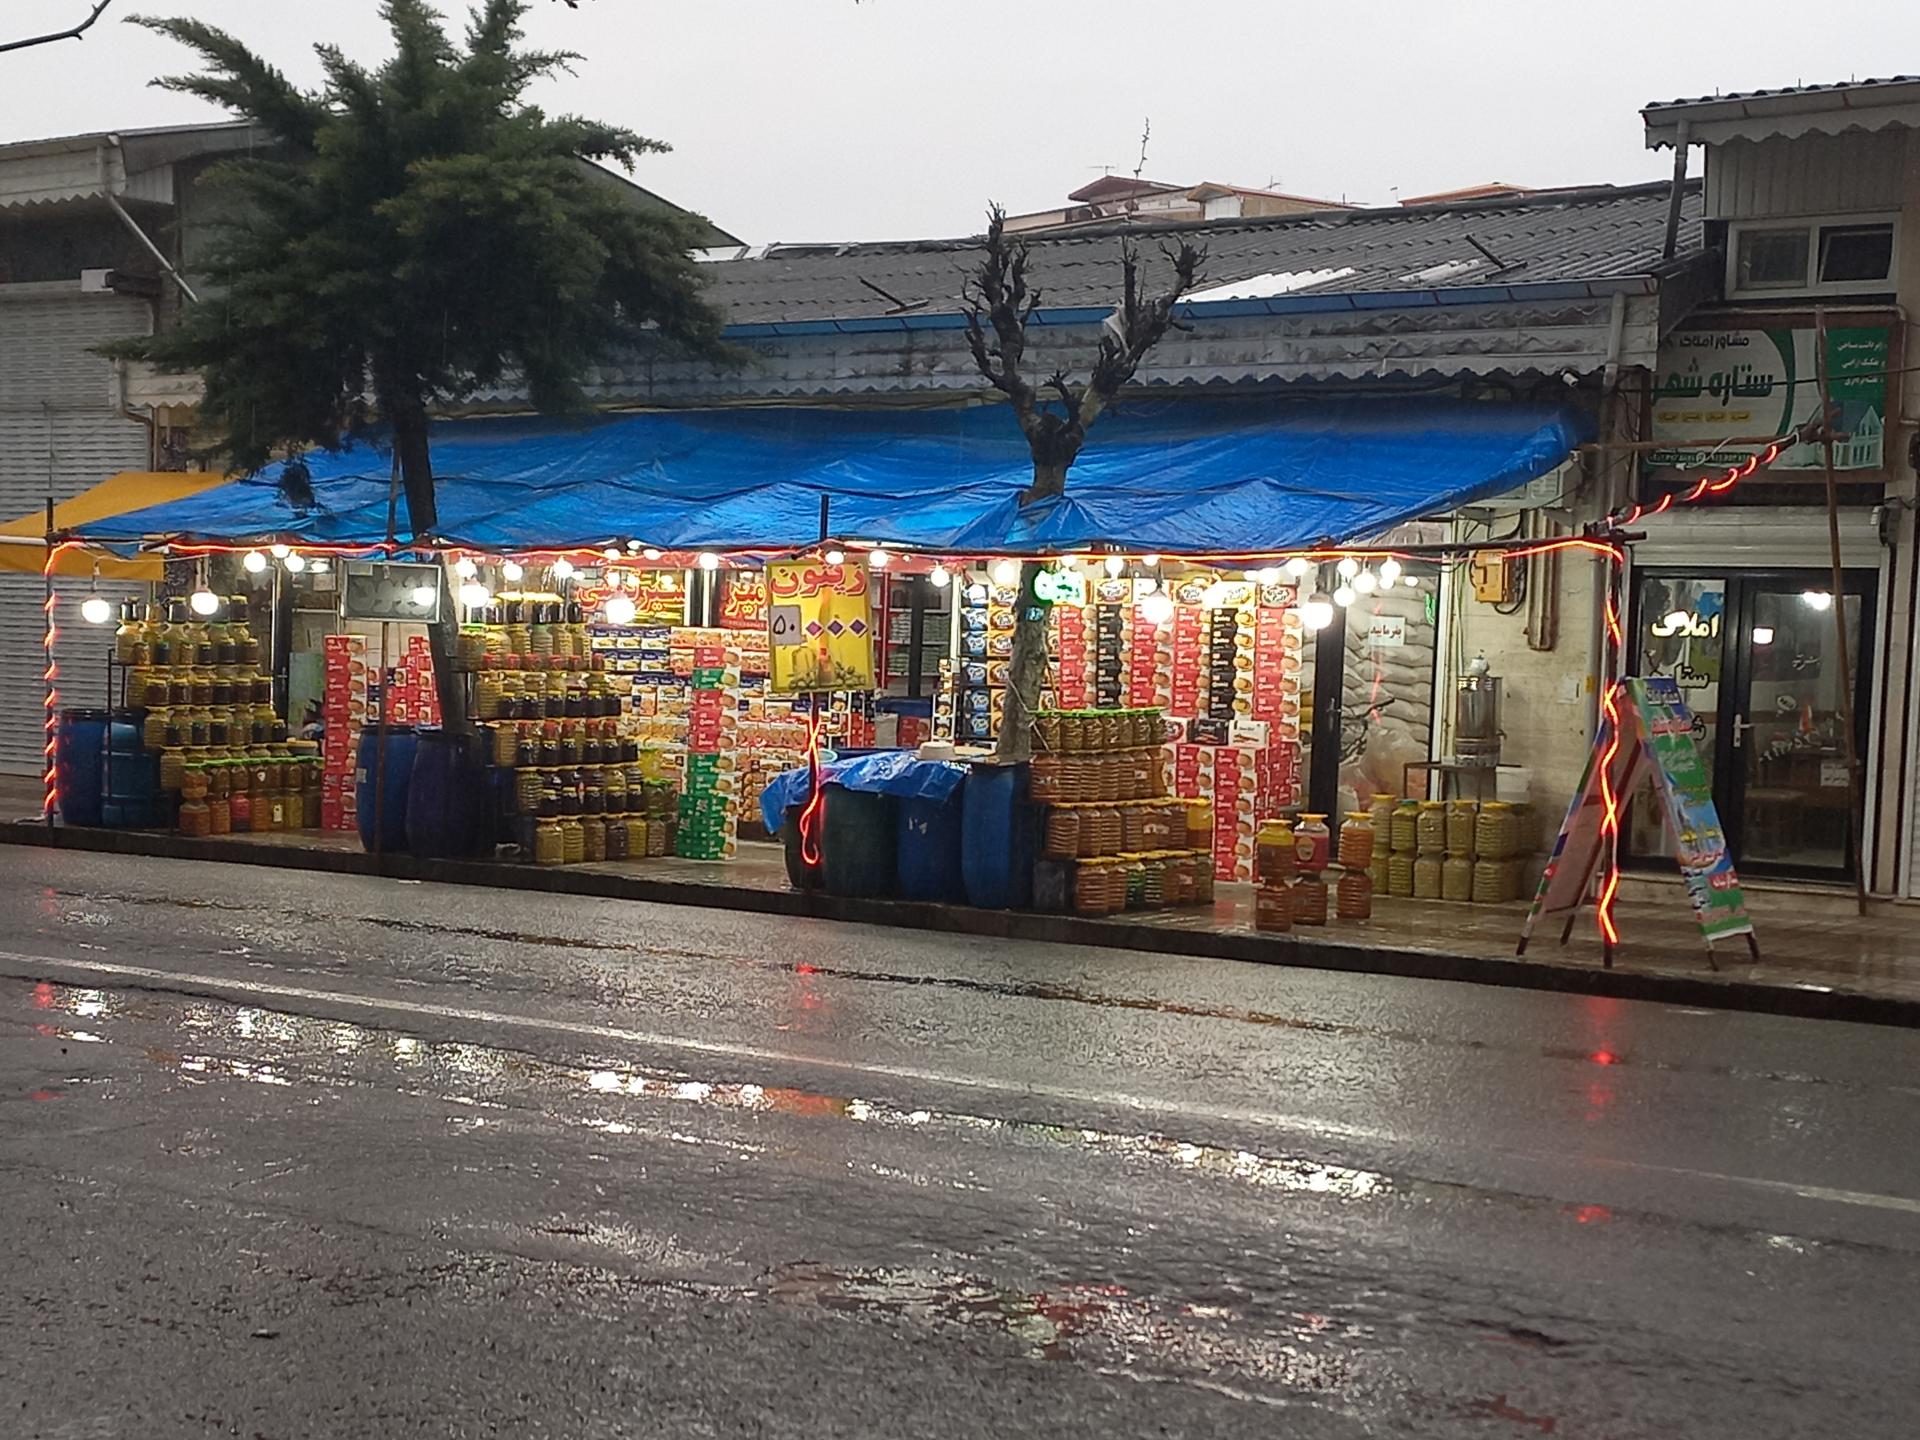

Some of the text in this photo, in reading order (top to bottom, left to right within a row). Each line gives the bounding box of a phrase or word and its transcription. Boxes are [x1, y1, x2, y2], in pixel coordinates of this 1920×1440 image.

[1715, 330, 1750, 350] مشاور
[1709, 363, 1774, 407] ستاره
[770, 562, 867, 596] زیتون
[1651, 610, 1720, 638] املاک
